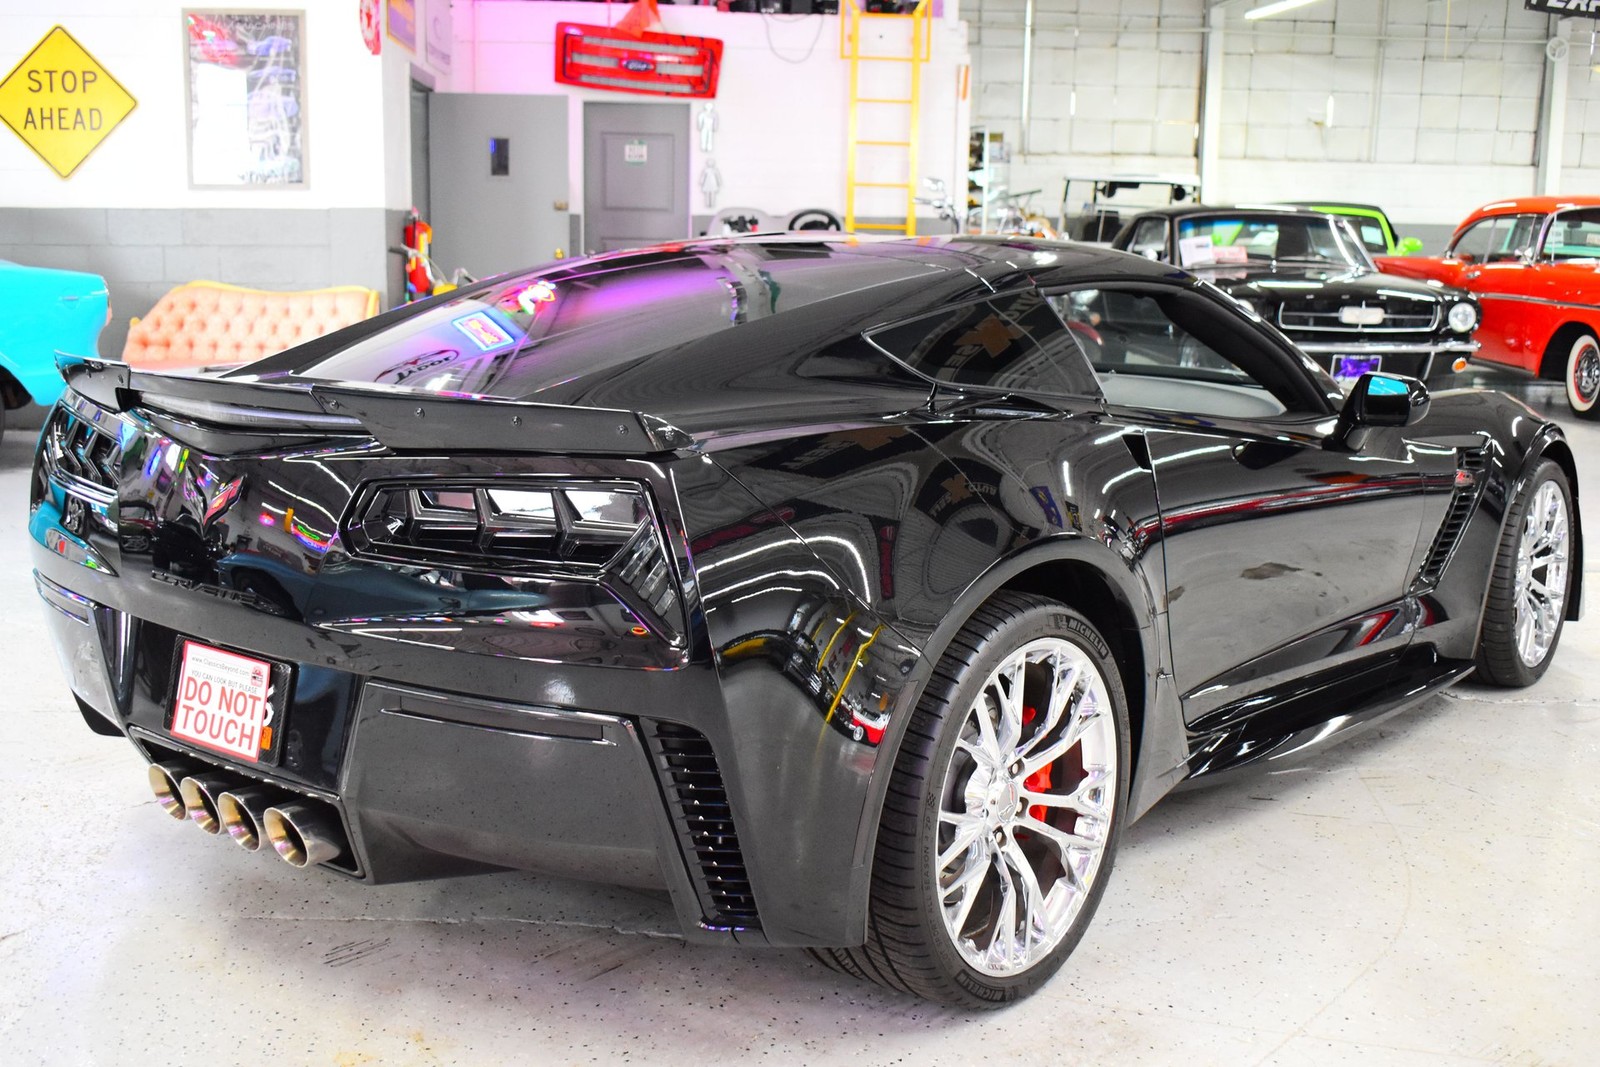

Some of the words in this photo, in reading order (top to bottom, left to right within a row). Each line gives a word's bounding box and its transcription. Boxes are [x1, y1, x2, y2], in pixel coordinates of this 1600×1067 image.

[27, 69, 99, 94] STOP
[23, 107, 104, 131] AHEAD
[1068, 618, 1108, 657] MICHELIN
[184, 676, 212, 706] DO
[218, 686, 261, 720] NOT
[202, 672, 213, 681] CAN
[214, 676, 227, 685] LOOK
[228, 679, 238, 688] BUT
[239, 683, 258, 695] PLEASE
[182, 704, 255, 751] TOUCH
[923, 846, 931, 891] SEASON
[955, 972, 1004, 1001] MICHELIN
